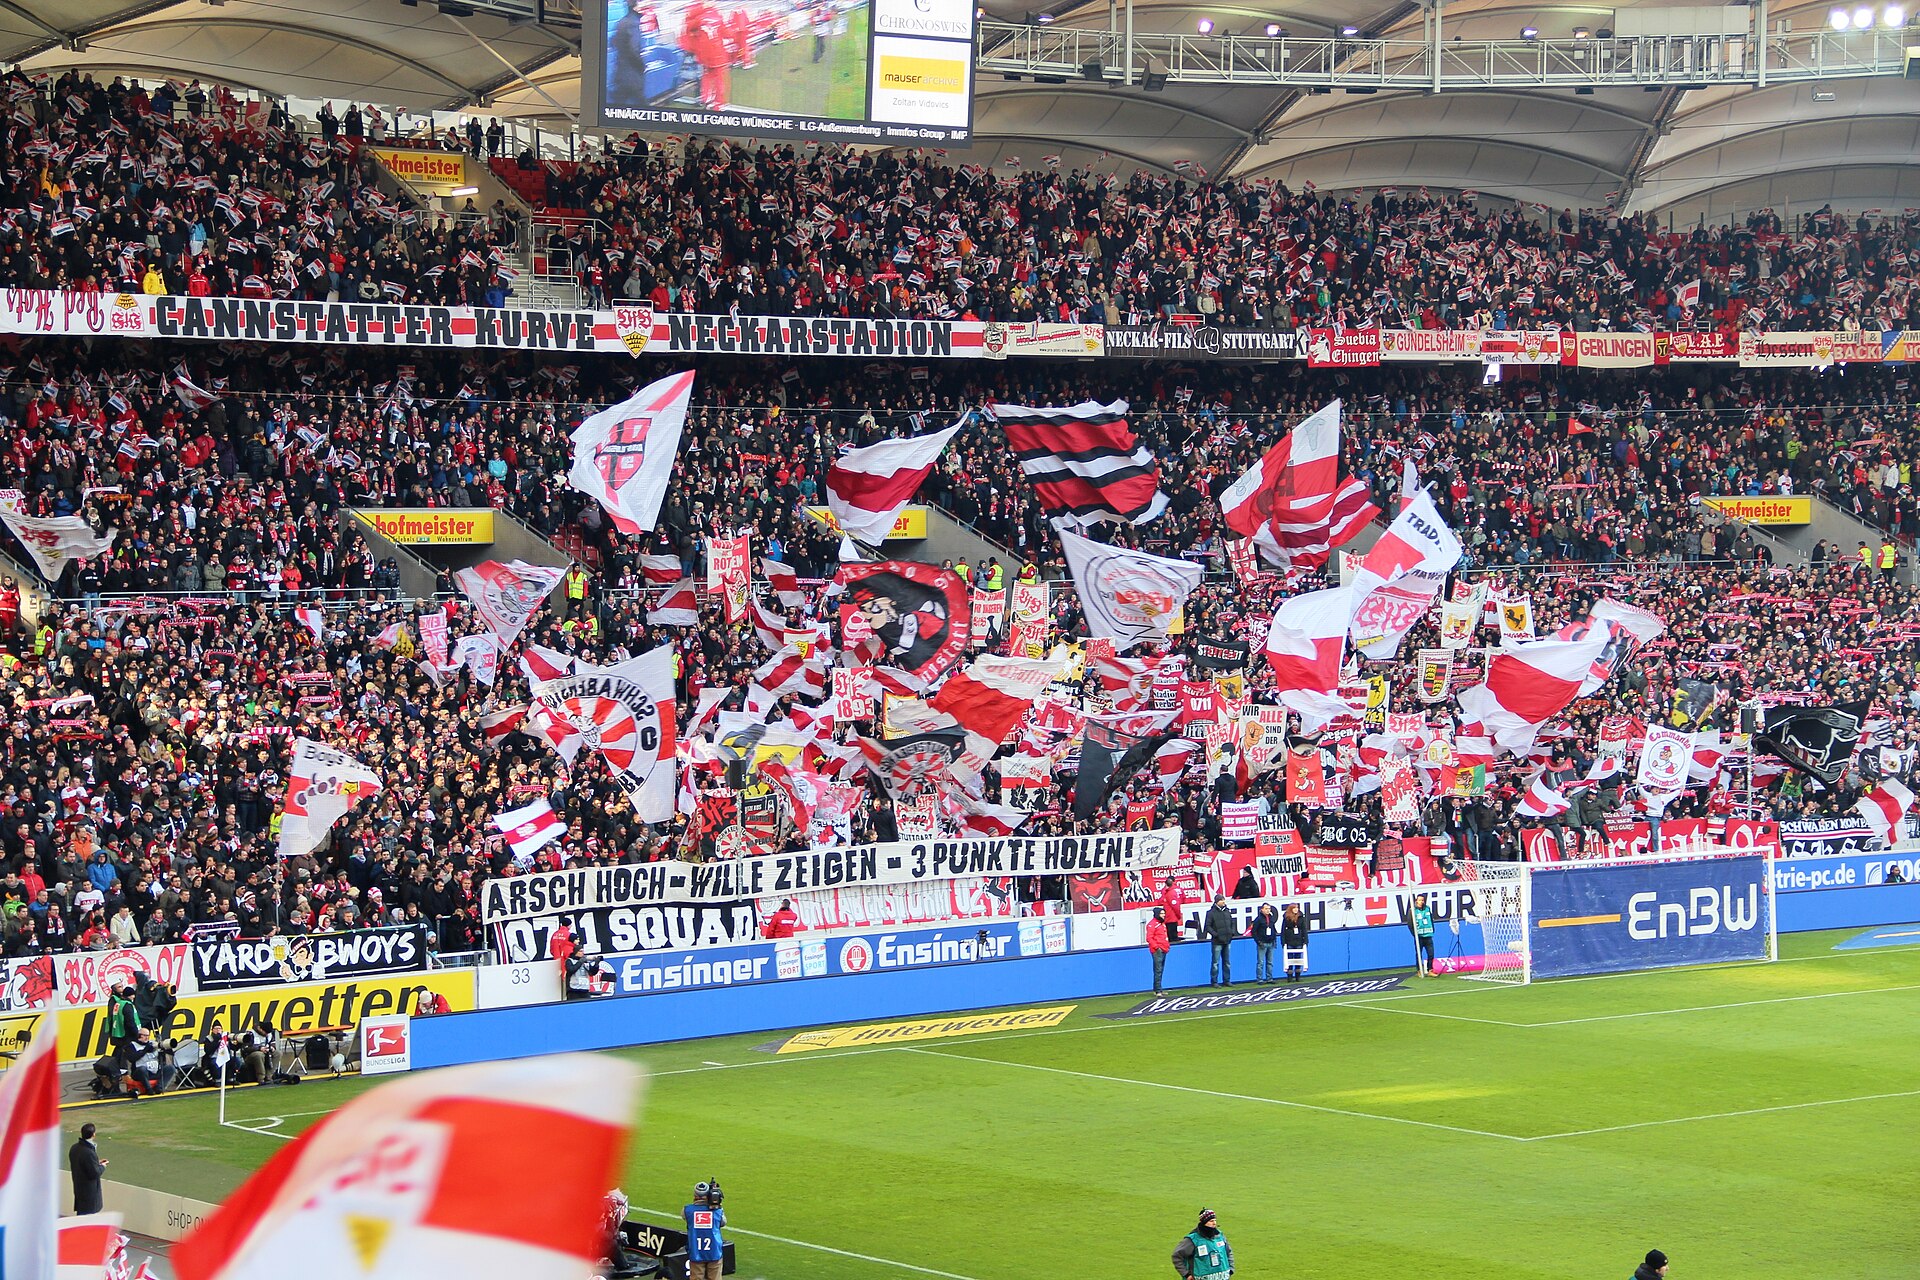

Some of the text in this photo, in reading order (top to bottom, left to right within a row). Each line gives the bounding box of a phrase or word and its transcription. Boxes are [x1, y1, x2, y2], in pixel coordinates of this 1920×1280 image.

[879, 14, 968, 34] CHRONOSWISS
[892, 97, 949, 109] Zoltan Vidovics
[661, 111, 679, 123] DR.
[681, 113, 741, 127] WOLFGANG
[741, 116, 793, 130] WÜNSCHE
[919, 128, 946, 141] Group
[383, 154, 461, 175] ofmeister
[156, 296, 595, 351] CANNSTATTER KURVE
[617, 306, 654, 330] VfB
[669, 314, 952, 356] NECKARSTADION
[1106, 330, 1295, 350] NECKAR-FILS STUTTGART
[1396, 332, 1465, 352] GUNDELSHEIM
[1834, 332, 1863, 343] FEUE
[1580, 337, 1651, 358] GERLINGEN
[1719, 500, 1792, 518] hofmeister
[376, 514, 475, 536] hofmeister
[713, 555, 743, 571] ROTEN
[836, 699, 874, 718] 1893
[1190, 697, 1212, 712] 0711
[1242, 705, 1260, 717] WIR
[1259, 710, 1283, 723] ALLE
[1388, 714, 1424, 735] VfB
[1265, 723, 1282, 734] SIND
[1265, 736, 1278, 745] DER
[1649, 730, 1691, 750] Commando
[1645, 771, 1681, 787] Cannstatt
[1321, 825, 1367, 845] BC 05
[1779, 818, 1839, 833] SCHWABEN
[487, 871, 586, 919] ARSCH
[595, 866, 667, 904] HOCH
[690, 859, 764, 898] WILLE
[774, 848, 877, 890] ZEIGEN
[911, 844, 926, 879] 3
[933, 837, 1037, 877] PUNKTE
[1044, 835, 1134, 872] HOLEN!
[1775, 862, 1856, 890] trie-pc.de
[1628, 883, 1758, 940] EnBW
[505, 904, 756, 963] 071 SQUAD
[1100, 916, 1116, 931] 34
[1021, 936, 1041, 944] Ensinger
[1045, 932, 1064, 940] Ensinger
[1046, 938, 1065, 949] SPORT
[197, 931, 417, 979] YARD BWOYS
[804, 952, 825, 962] Ensinger
[876, 932, 1013, 968] Ensinger
[1022, 944, 1041, 953] SPORT
[778, 958, 799, 968] Ensinger
[779, 965, 800, 977] SPORT
[805, 960, 825, 970] SPORT
[511, 968, 531, 985] 33
[621, 956, 770, 992] Ensinger
[1132, 977, 1400, 1017] Mercedes-Benz
[74, 983, 432, 1059] Ierwetten
[849, 1009, 1064, 1042] Interwetten
[365, 1056, 406, 1067] BUNDESLIGA
[167, 1209, 192, 1230] SHOP
[637, 1226, 665, 1256] sky
[696, 1237, 711, 1251] 12
